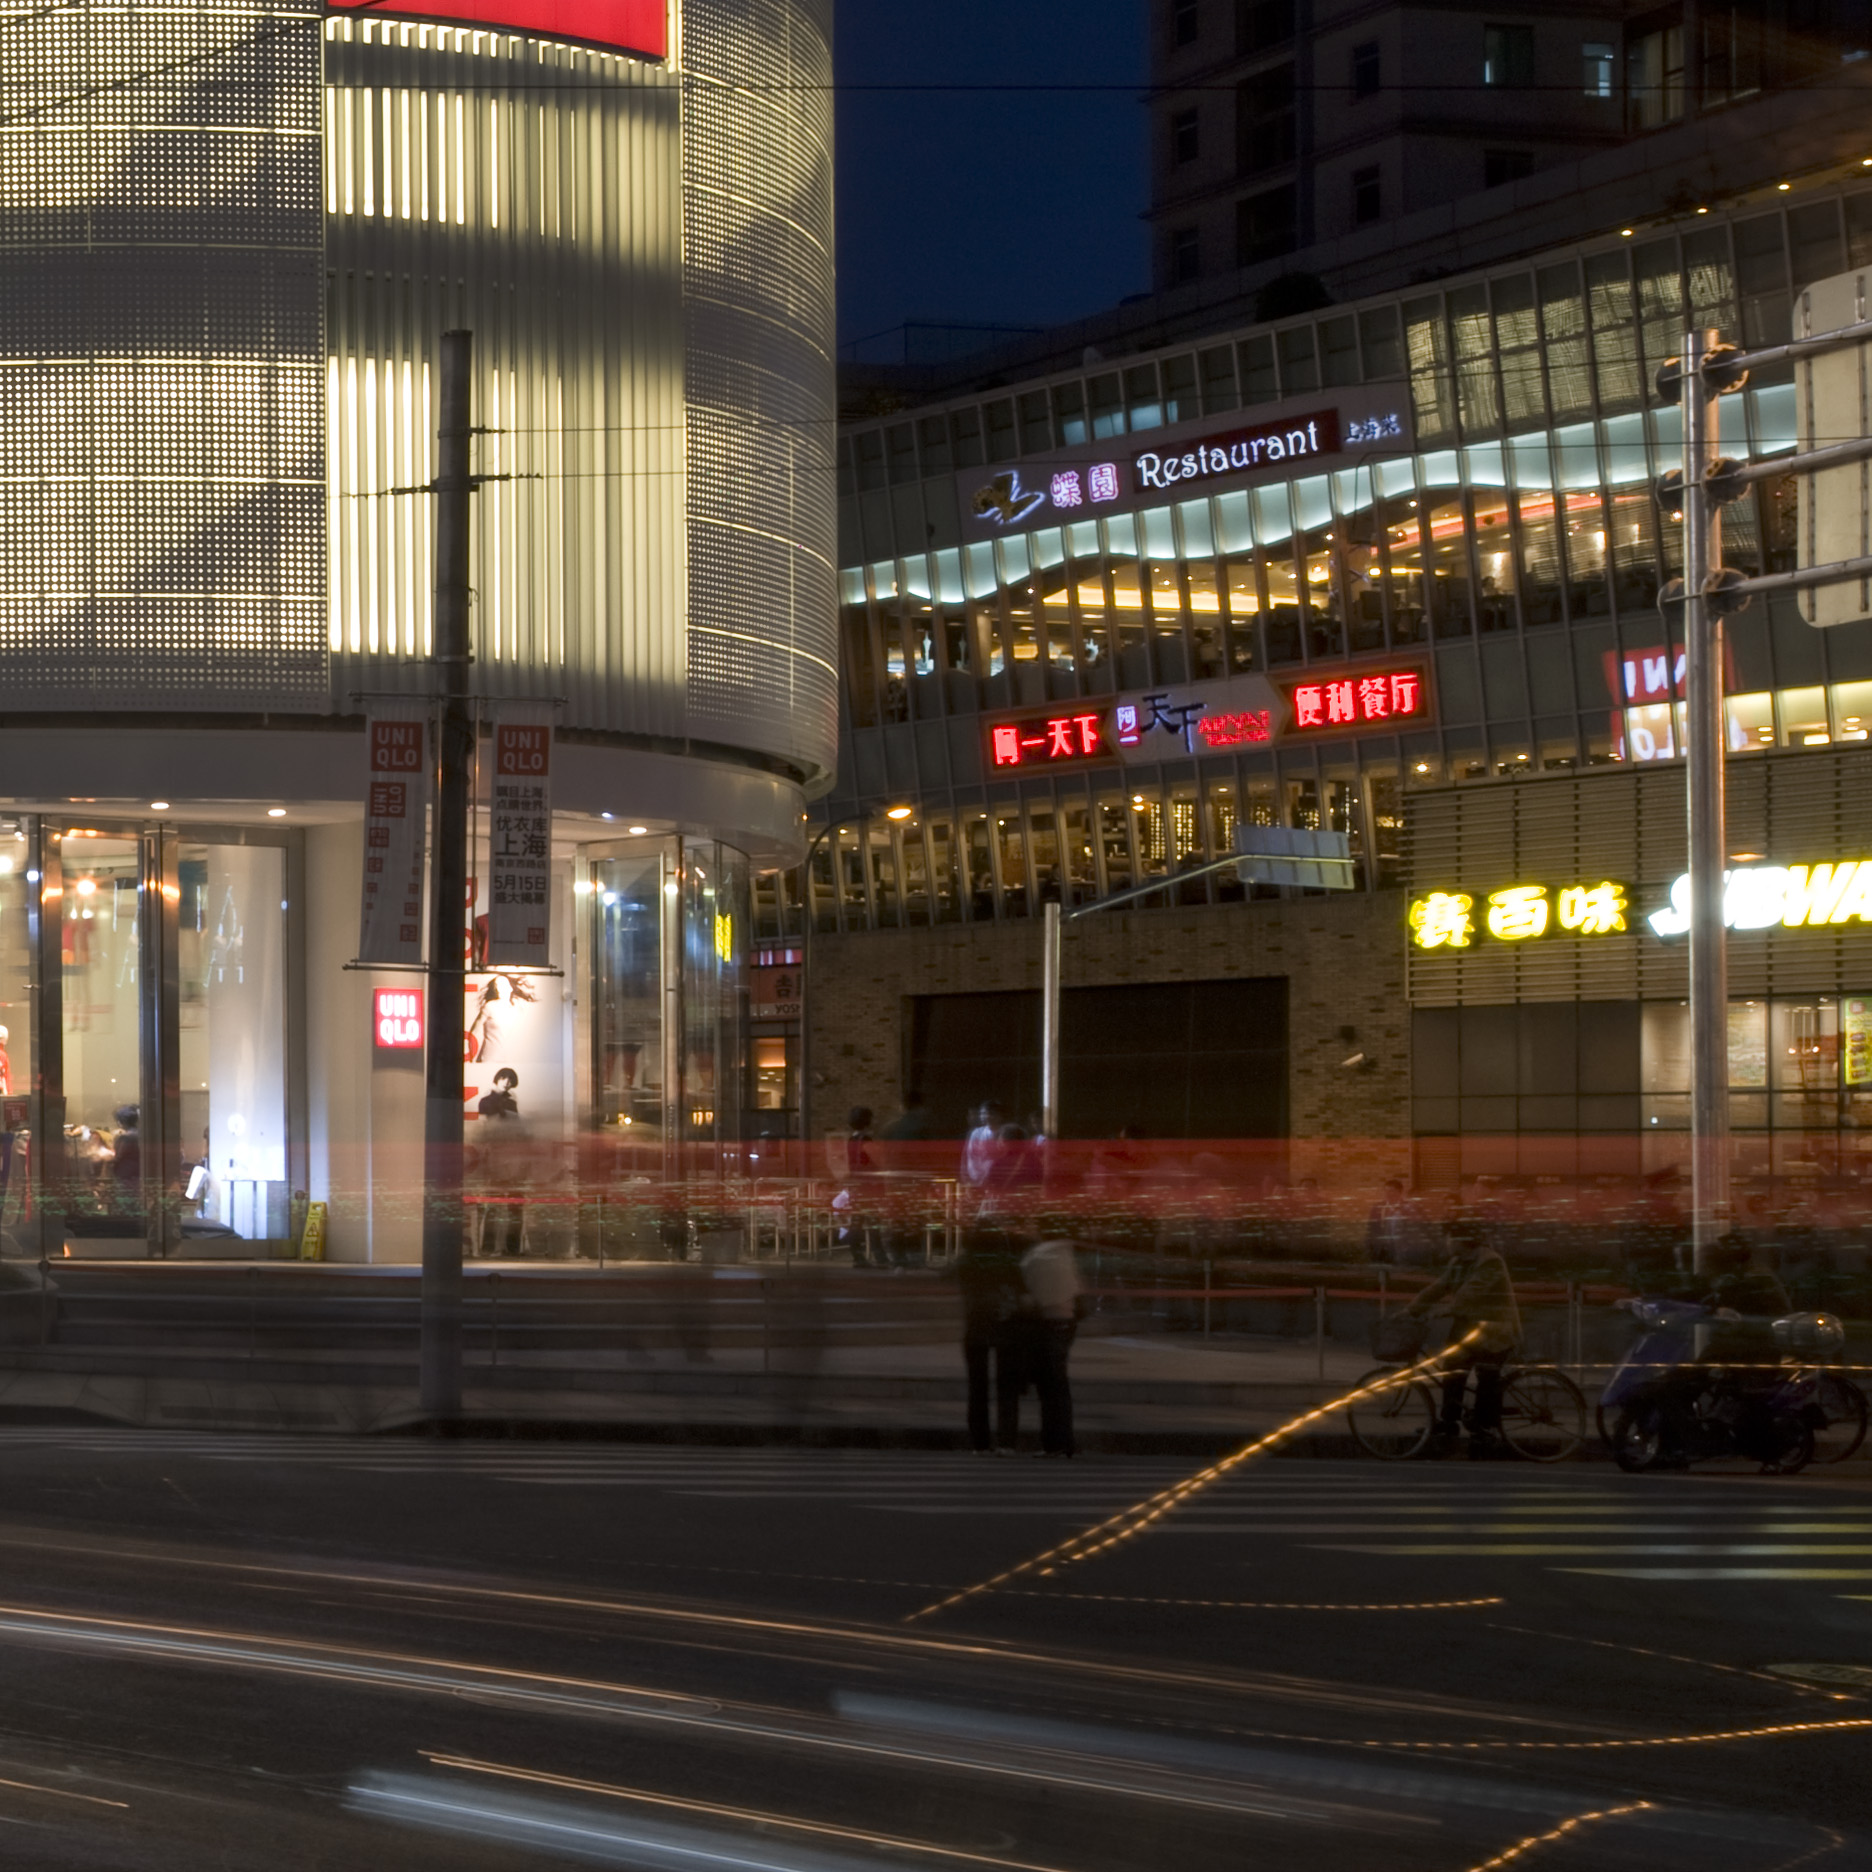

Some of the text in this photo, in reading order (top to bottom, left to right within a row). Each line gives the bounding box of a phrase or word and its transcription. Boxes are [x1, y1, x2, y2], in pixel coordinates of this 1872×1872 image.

[1136, 420, 1319, 489] Restaurant
[1294, 673, 1419, 727] 便利餐厅
[376, 727, 414, 745] UNI
[503, 731, 541, 749] UNI
[376, 748, 417, 769] QLO
[503, 752, 543, 772] QLO
[496, 816, 547, 833] 优衣库
[495, 833, 547, 858] 上海
[494, 875, 546, 890] 5月15日
[380, 994, 416, 1017] UNI
[380, 1018, 419, 1044] QLO
